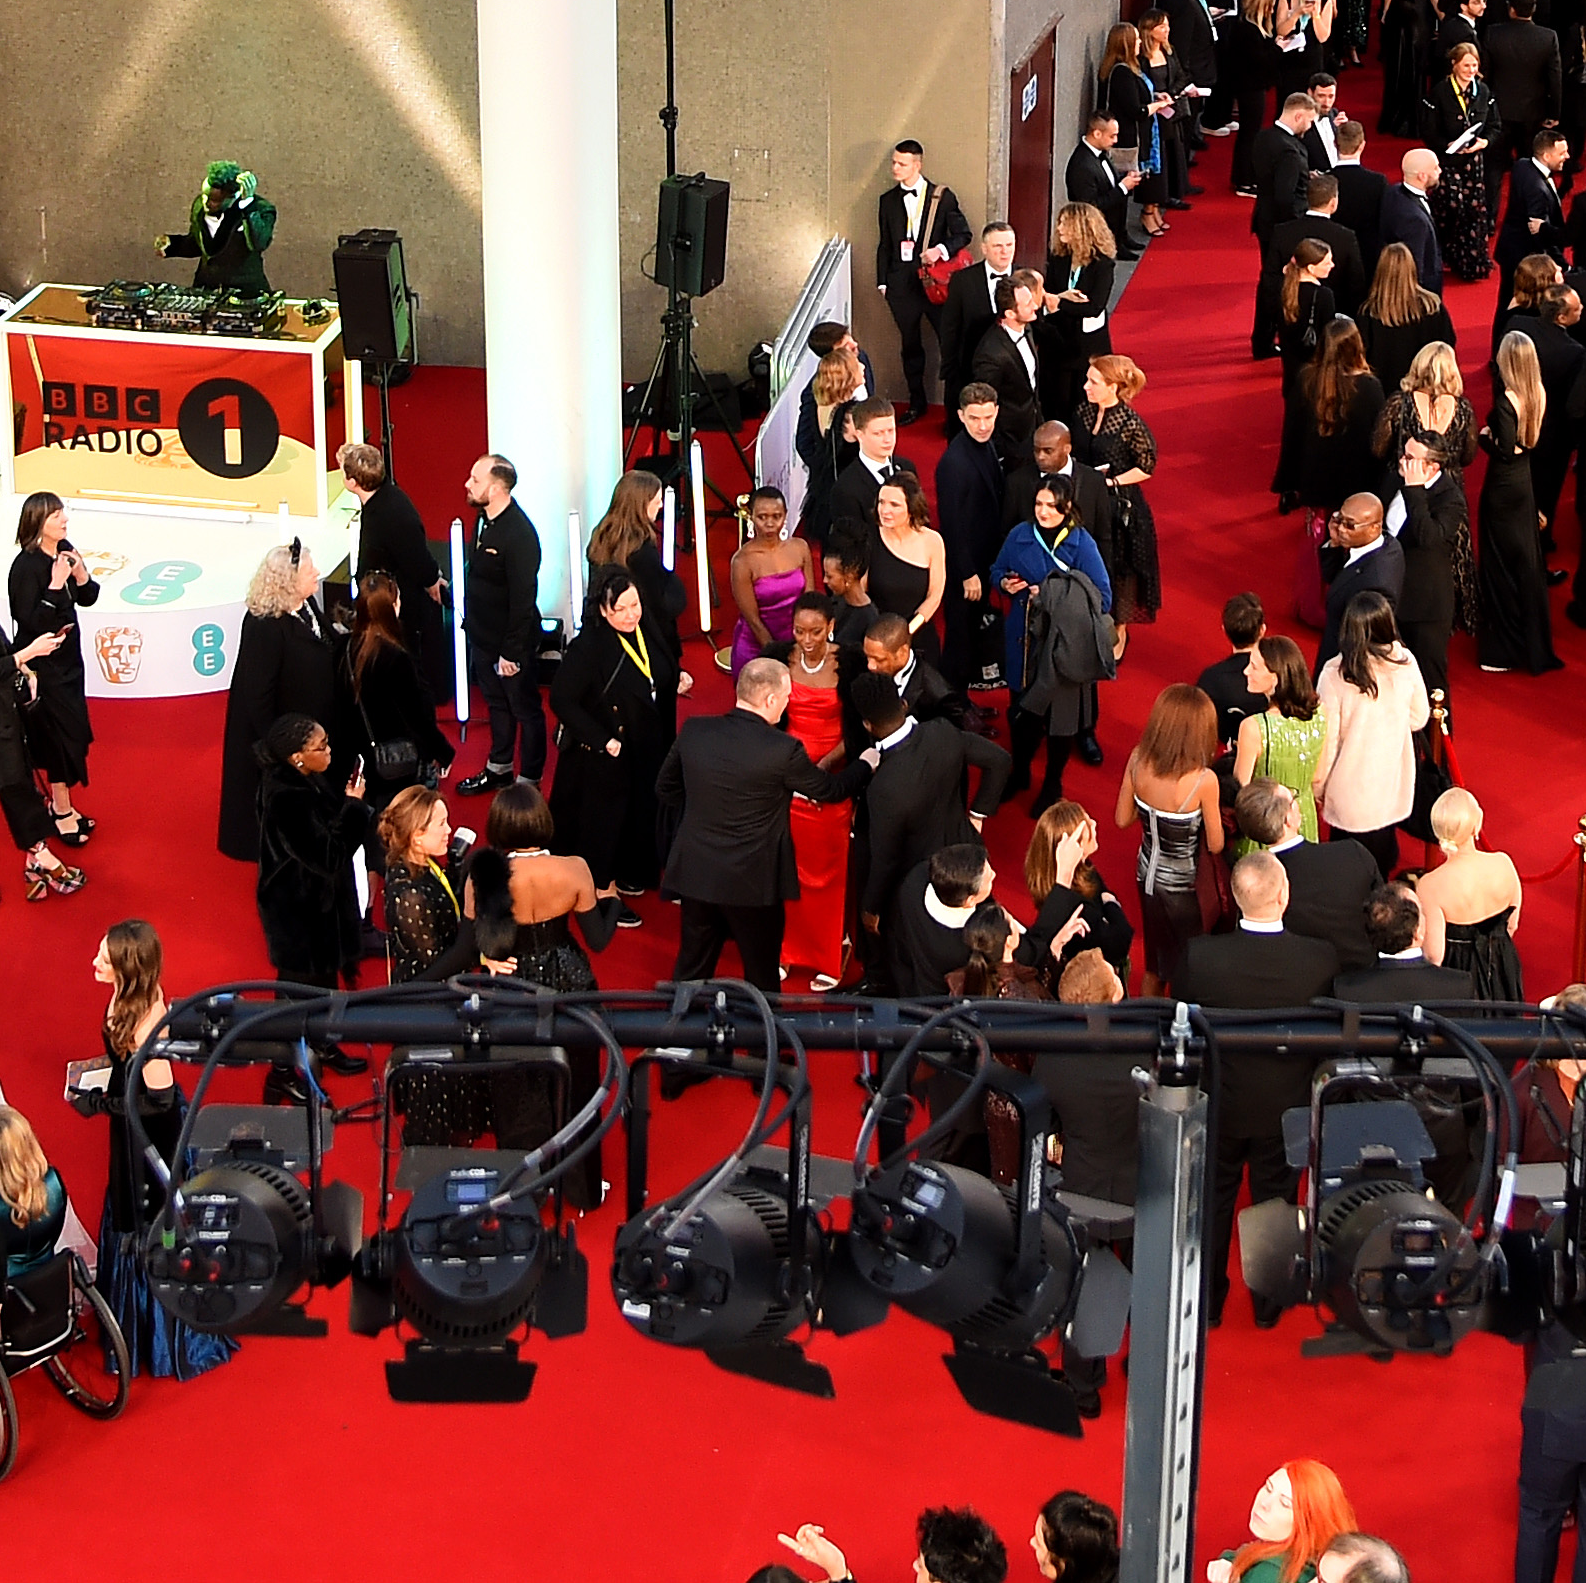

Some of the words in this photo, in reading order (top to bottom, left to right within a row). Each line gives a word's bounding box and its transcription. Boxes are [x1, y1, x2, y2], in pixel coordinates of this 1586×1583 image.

[48, 387, 154, 418] BBC
[44, 421, 163, 458] RADIO
[207, 393, 243, 466] 1
